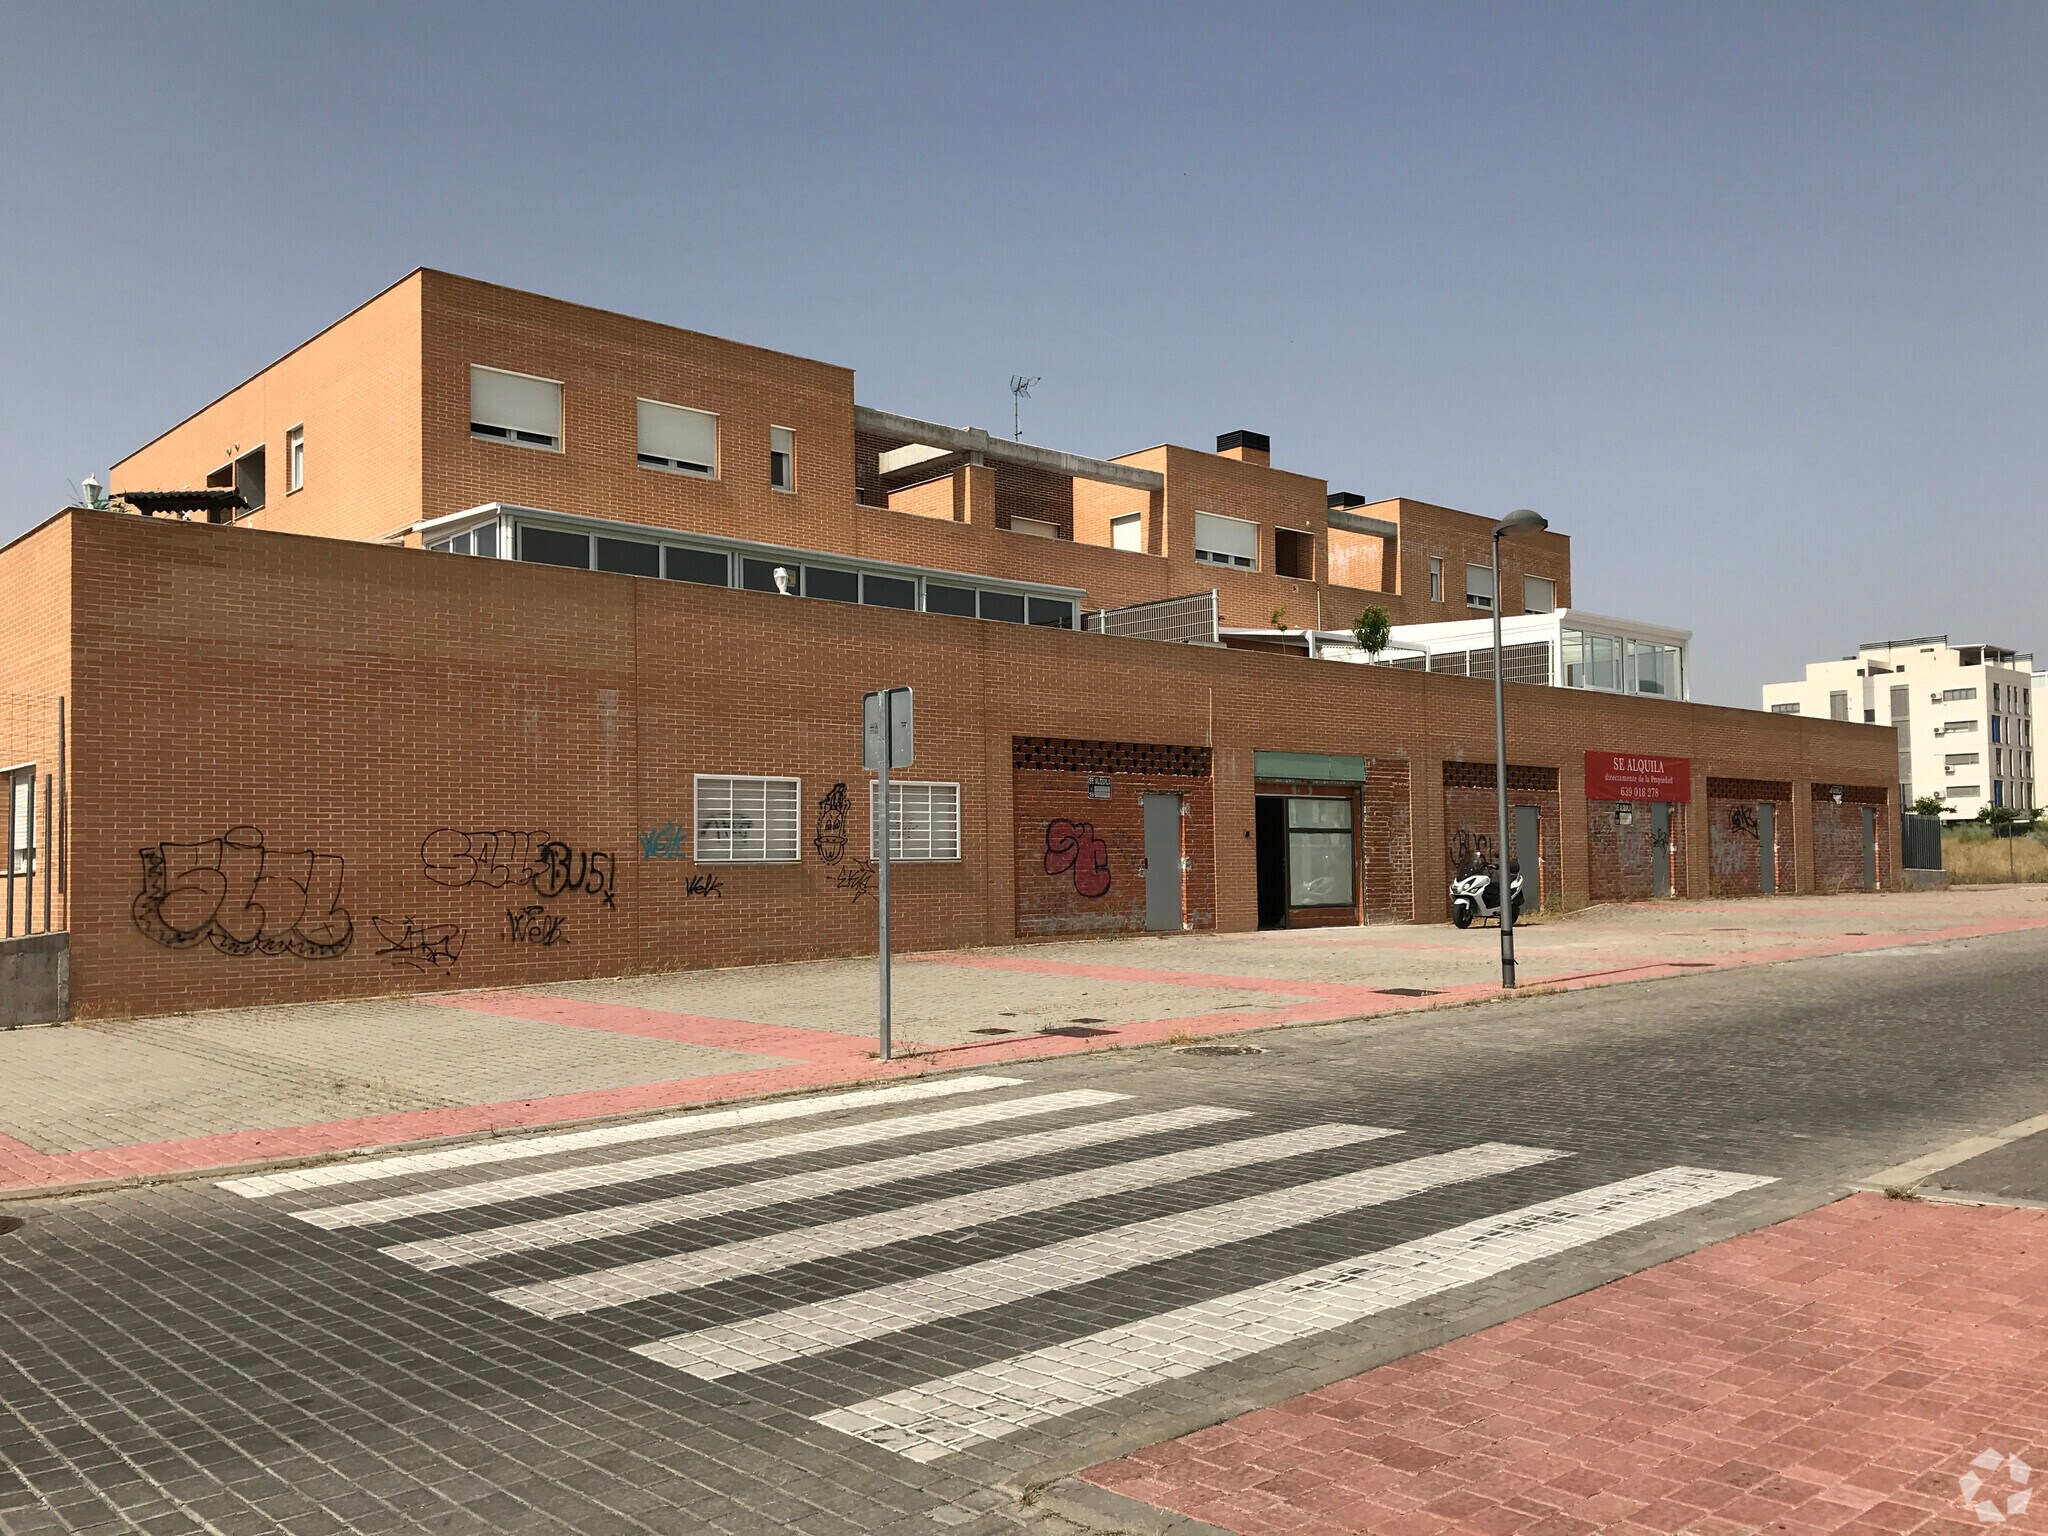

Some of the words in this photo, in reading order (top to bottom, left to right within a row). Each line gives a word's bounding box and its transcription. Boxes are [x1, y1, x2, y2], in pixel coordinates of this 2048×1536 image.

[1613, 757, 1625, 771] SE
[1626, 758, 1665, 773] ALQUILA
[1604, 772, 1638, 783] directamente
[1638, 774, 1645, 783] de
[1644, 775, 1650, 783] la
[1650, 776, 1674, 785] Propiedad
[1620, 786, 1633, 797] 639
[1634, 787, 1646, 798] 018
[1647, 787, 1659, 798] 278
